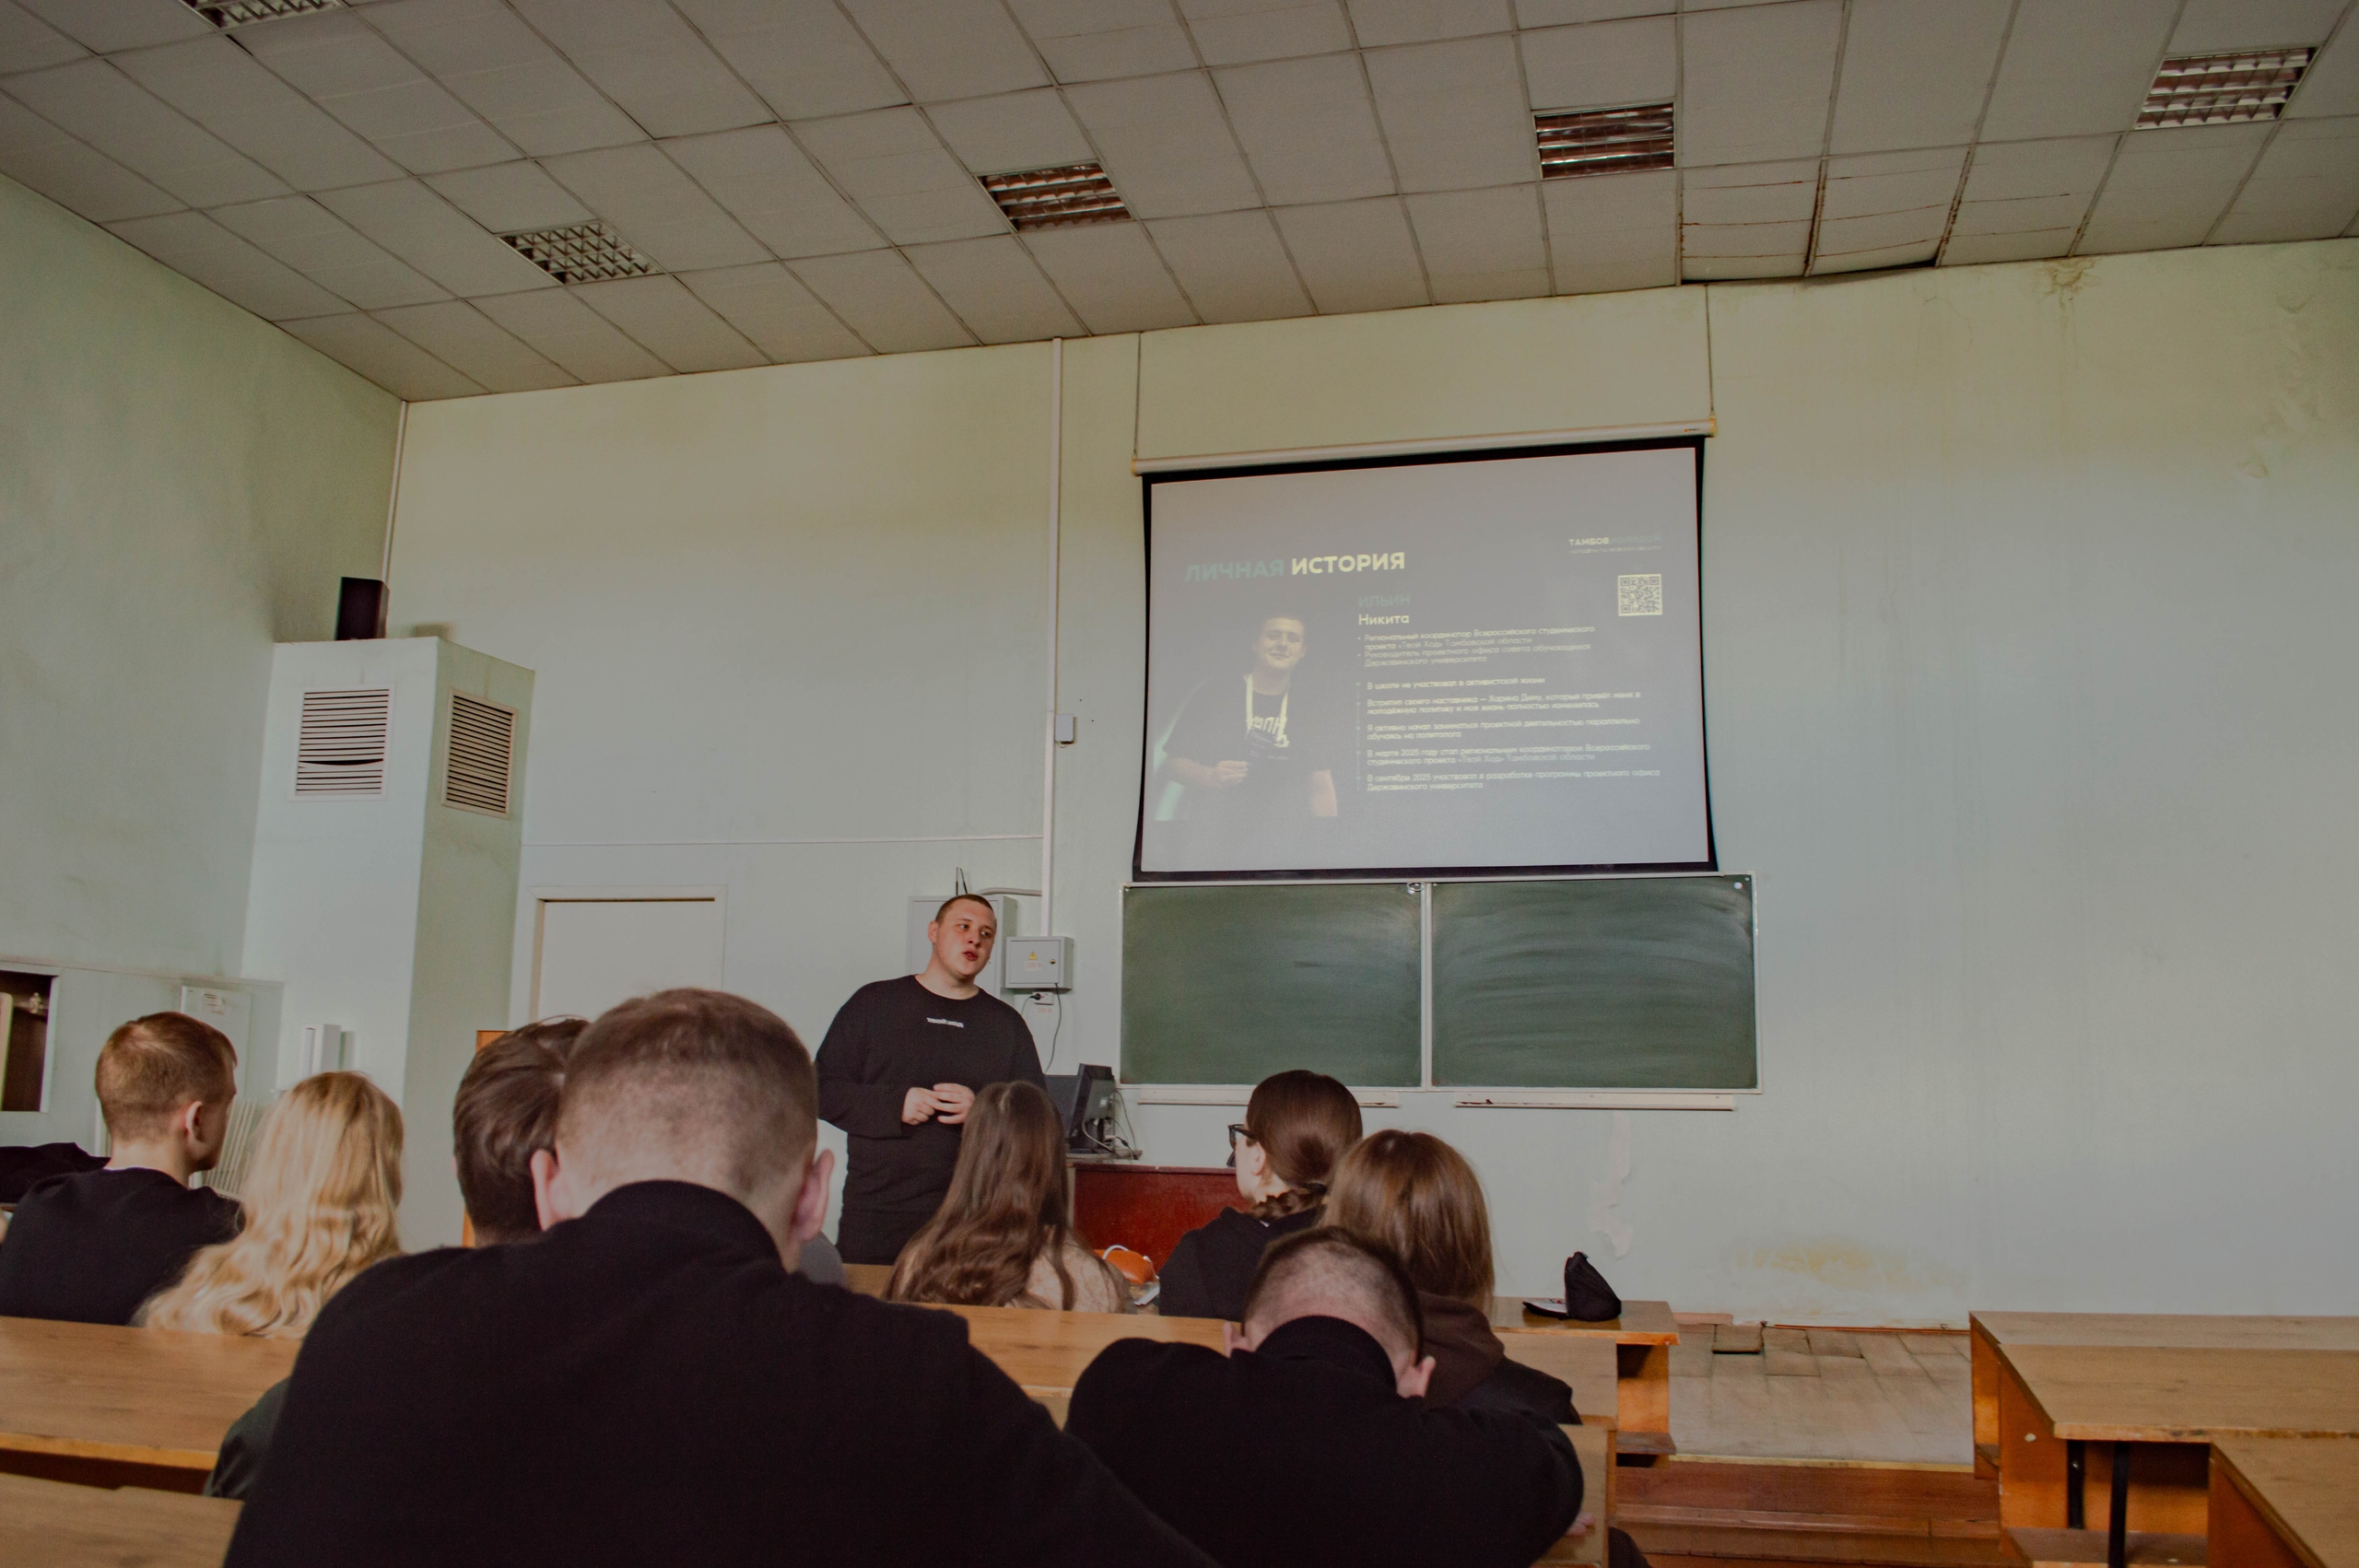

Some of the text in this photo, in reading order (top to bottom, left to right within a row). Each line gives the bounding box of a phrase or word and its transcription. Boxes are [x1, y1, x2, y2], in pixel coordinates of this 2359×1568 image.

[1568, 537, 1609, 545] ТАМБОВ
[1183, 552, 1405, 583] ЛИЧНАЯ ИСТОРИЯ
[1357, 594, 1411, 608] ИЛЬИН
[1358, 614, 1410, 626] Никита
[1420, 631, 1472, 640] координатор
[1473, 628, 1536, 638] Всероссийского
[1538, 626, 1595, 636] студенческого
[1365, 643, 1396, 651] проекта
[1446, 638, 1495, 647] Тамбовской
[1497, 637, 1532, 645] области
[1365, 650, 1420, 660] Руководитель
[1422, 649, 1469, 657] проектного
[1472, 647, 1500, 655] офиса
[1413, 681, 1457, 689] участвовал
[1545, 693, 1580, 702] который
[1418, 706, 1455, 714] политику
[1524, 720, 1584, 728] деятельностью
[1586, 718, 1640, 726] параллельно
[1520, 745, 1583, 754] координатором
[1585, 743, 1650, 753] Всероссийского
[1367, 758, 1422, 766] студенческого
[1424, 757, 1456, 766] проекта
[1559, 753, 1595, 761] области
[1433, 773, 1477, 781] участвовал
[1632, 769, 1661, 778] офиса
